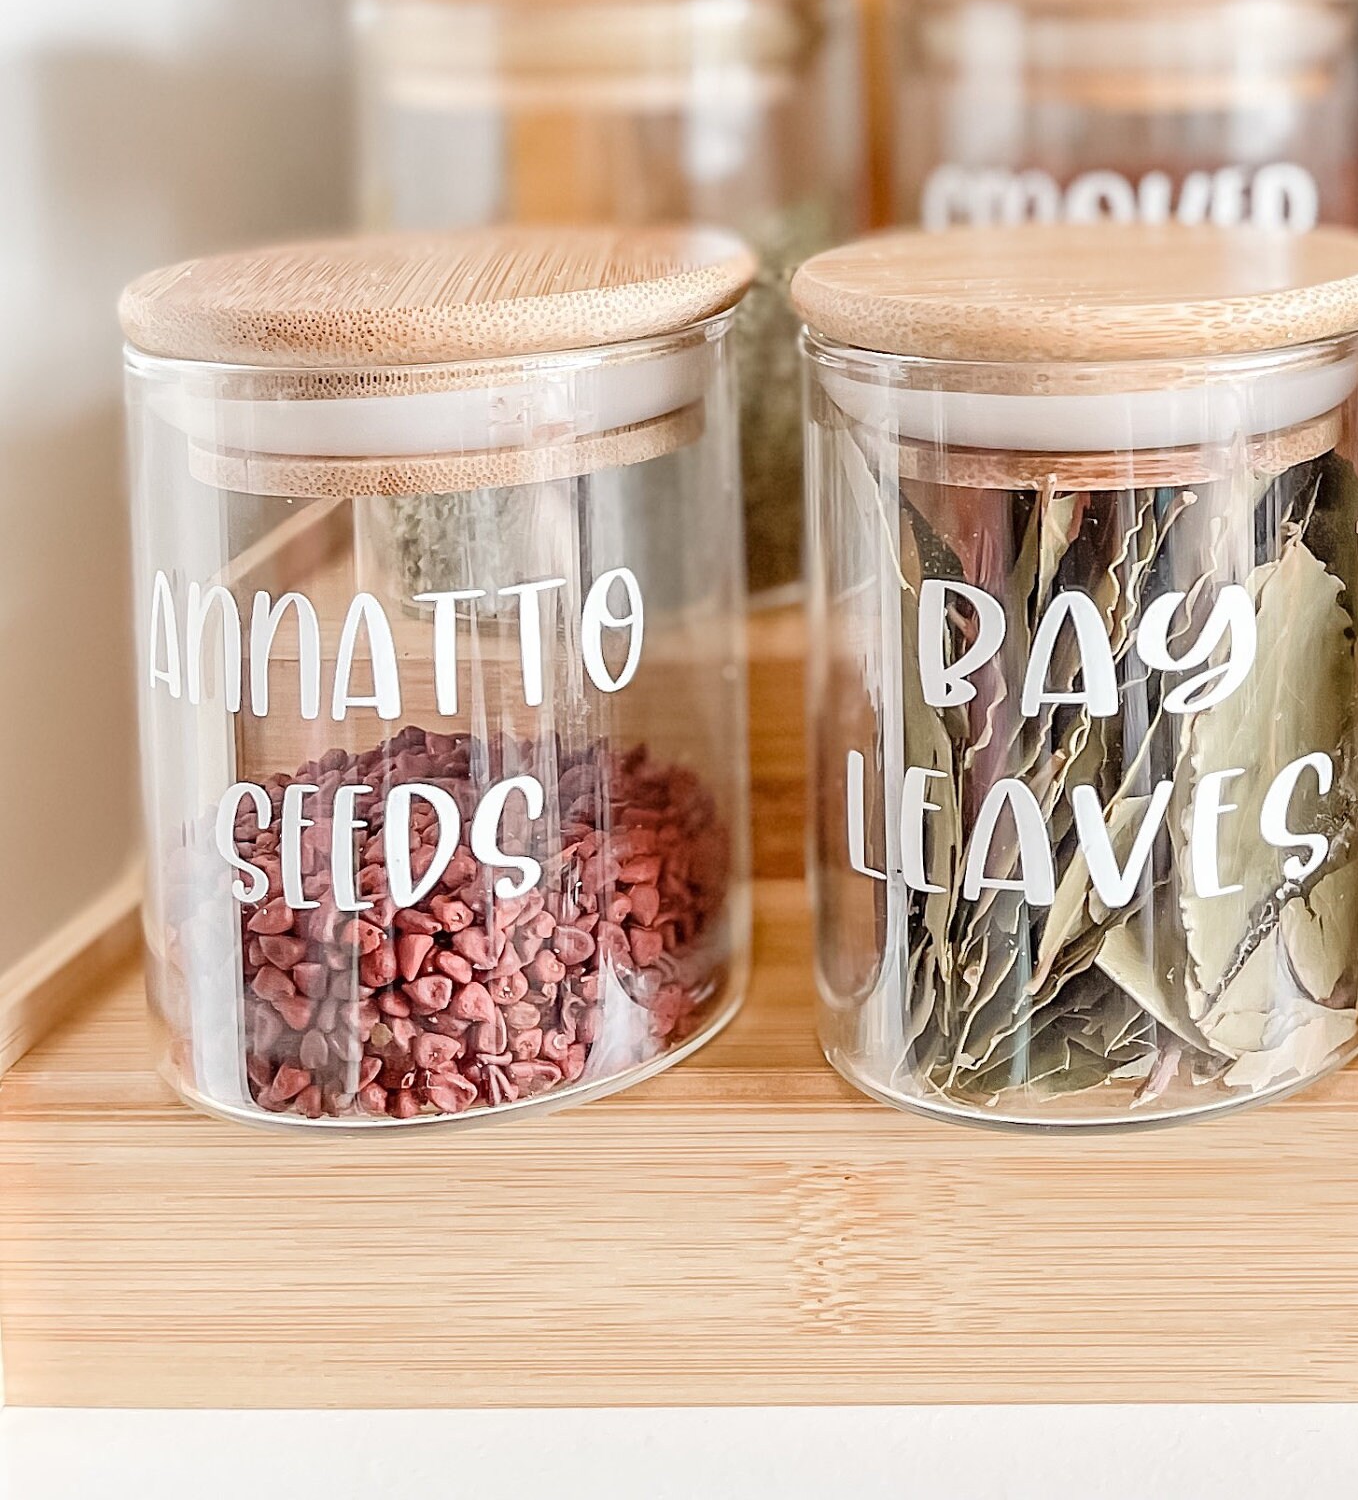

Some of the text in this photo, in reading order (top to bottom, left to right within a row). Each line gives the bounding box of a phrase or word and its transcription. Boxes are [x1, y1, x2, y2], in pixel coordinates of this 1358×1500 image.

[149, 566, 644, 721] ANNATTO
[917, 578, 1257, 717] BAY
[214, 774, 544, 911] SEEDS
[846, 751, 1334, 908] LEAVES
